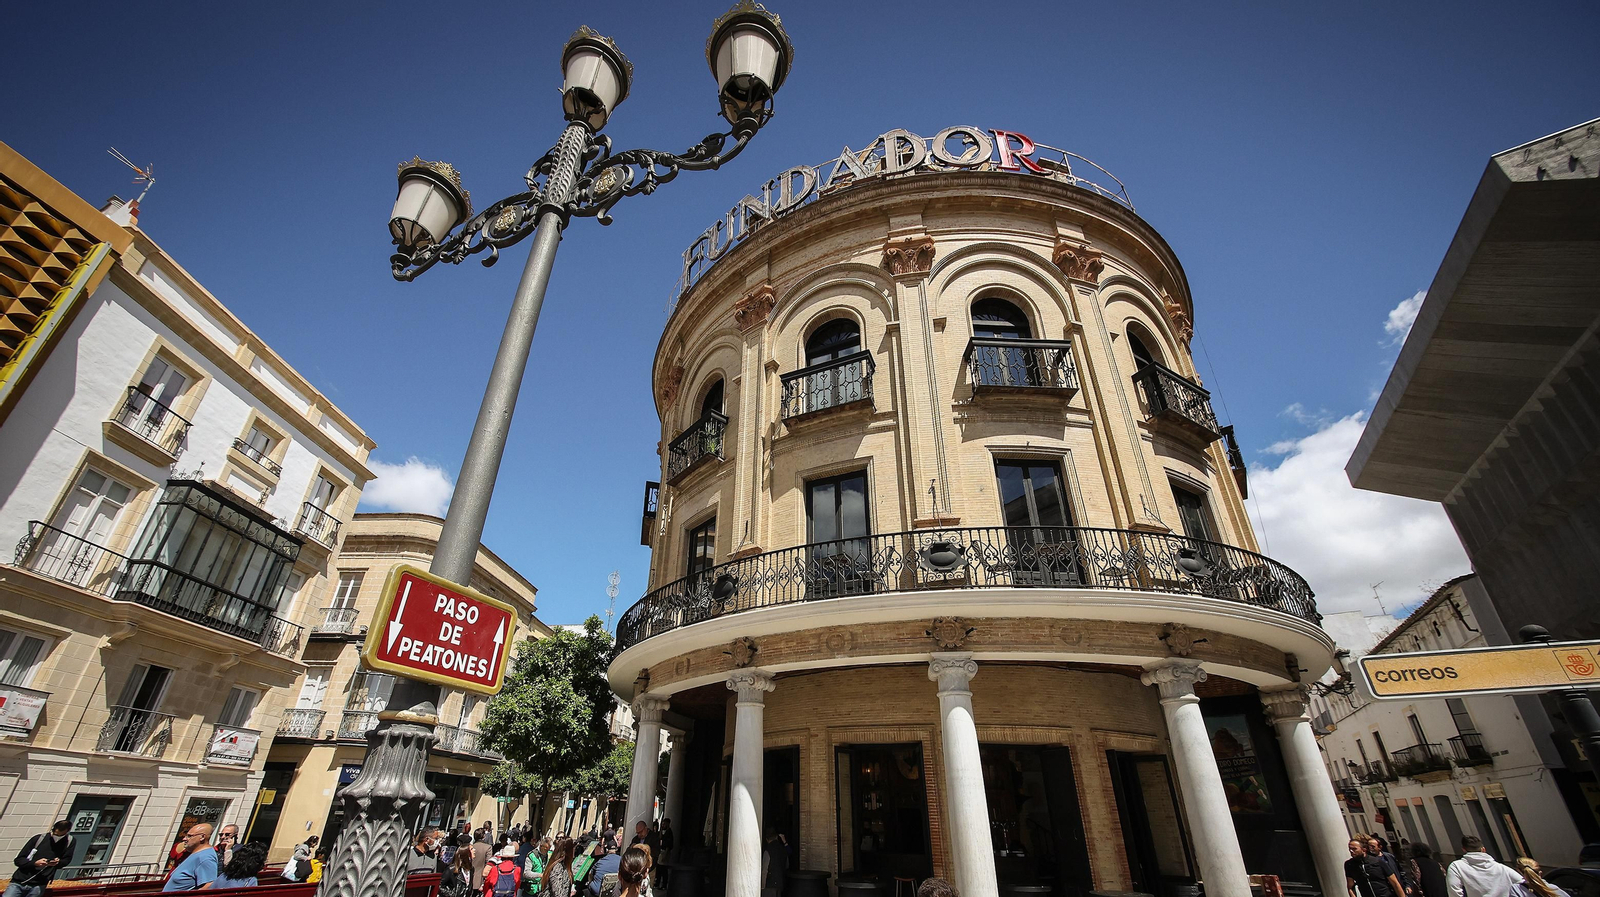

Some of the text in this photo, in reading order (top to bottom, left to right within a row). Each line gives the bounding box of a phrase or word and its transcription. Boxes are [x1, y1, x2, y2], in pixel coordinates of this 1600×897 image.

[678, 125, 1053, 298] FUNDADOR
[434, 593, 479, 624] PASO
[439, 621, 464, 646] DE
[397, 637, 488, 678] PEATONES
[1375, 666, 1458, 682] correos
